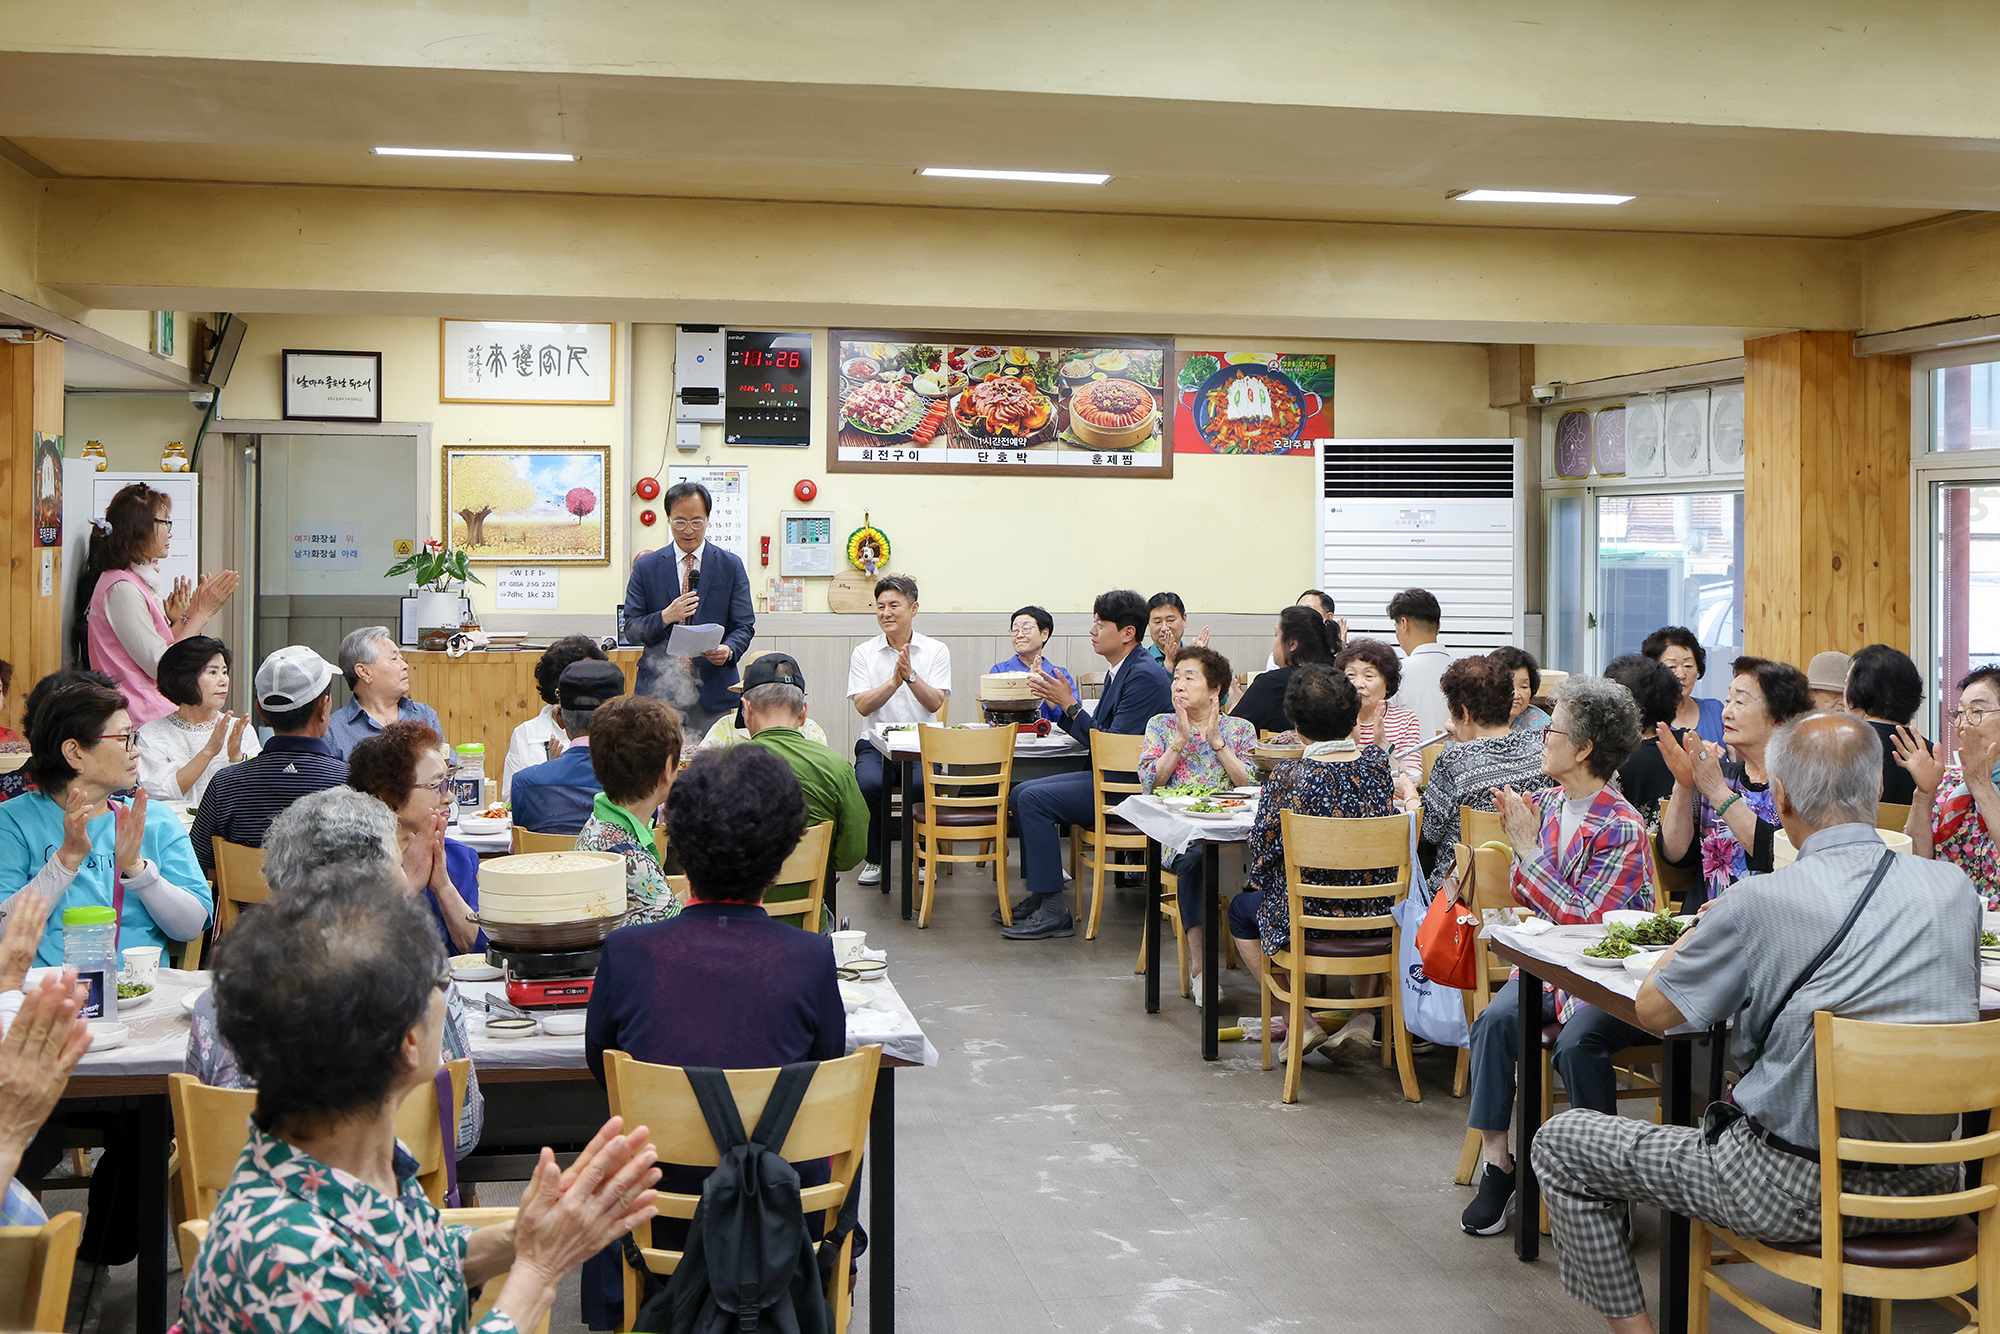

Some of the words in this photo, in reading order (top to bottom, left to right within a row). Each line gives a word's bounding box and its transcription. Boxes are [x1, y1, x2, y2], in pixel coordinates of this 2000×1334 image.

[775, 351, 800, 368] 26
[1273, 439, 1316, 450] 오리주물
[294, 535, 337, 543] 여자화장실
[345, 535, 354, 543] 위
[294, 550, 337, 559] 남자화장실
[341, 550, 359, 558] 아래
